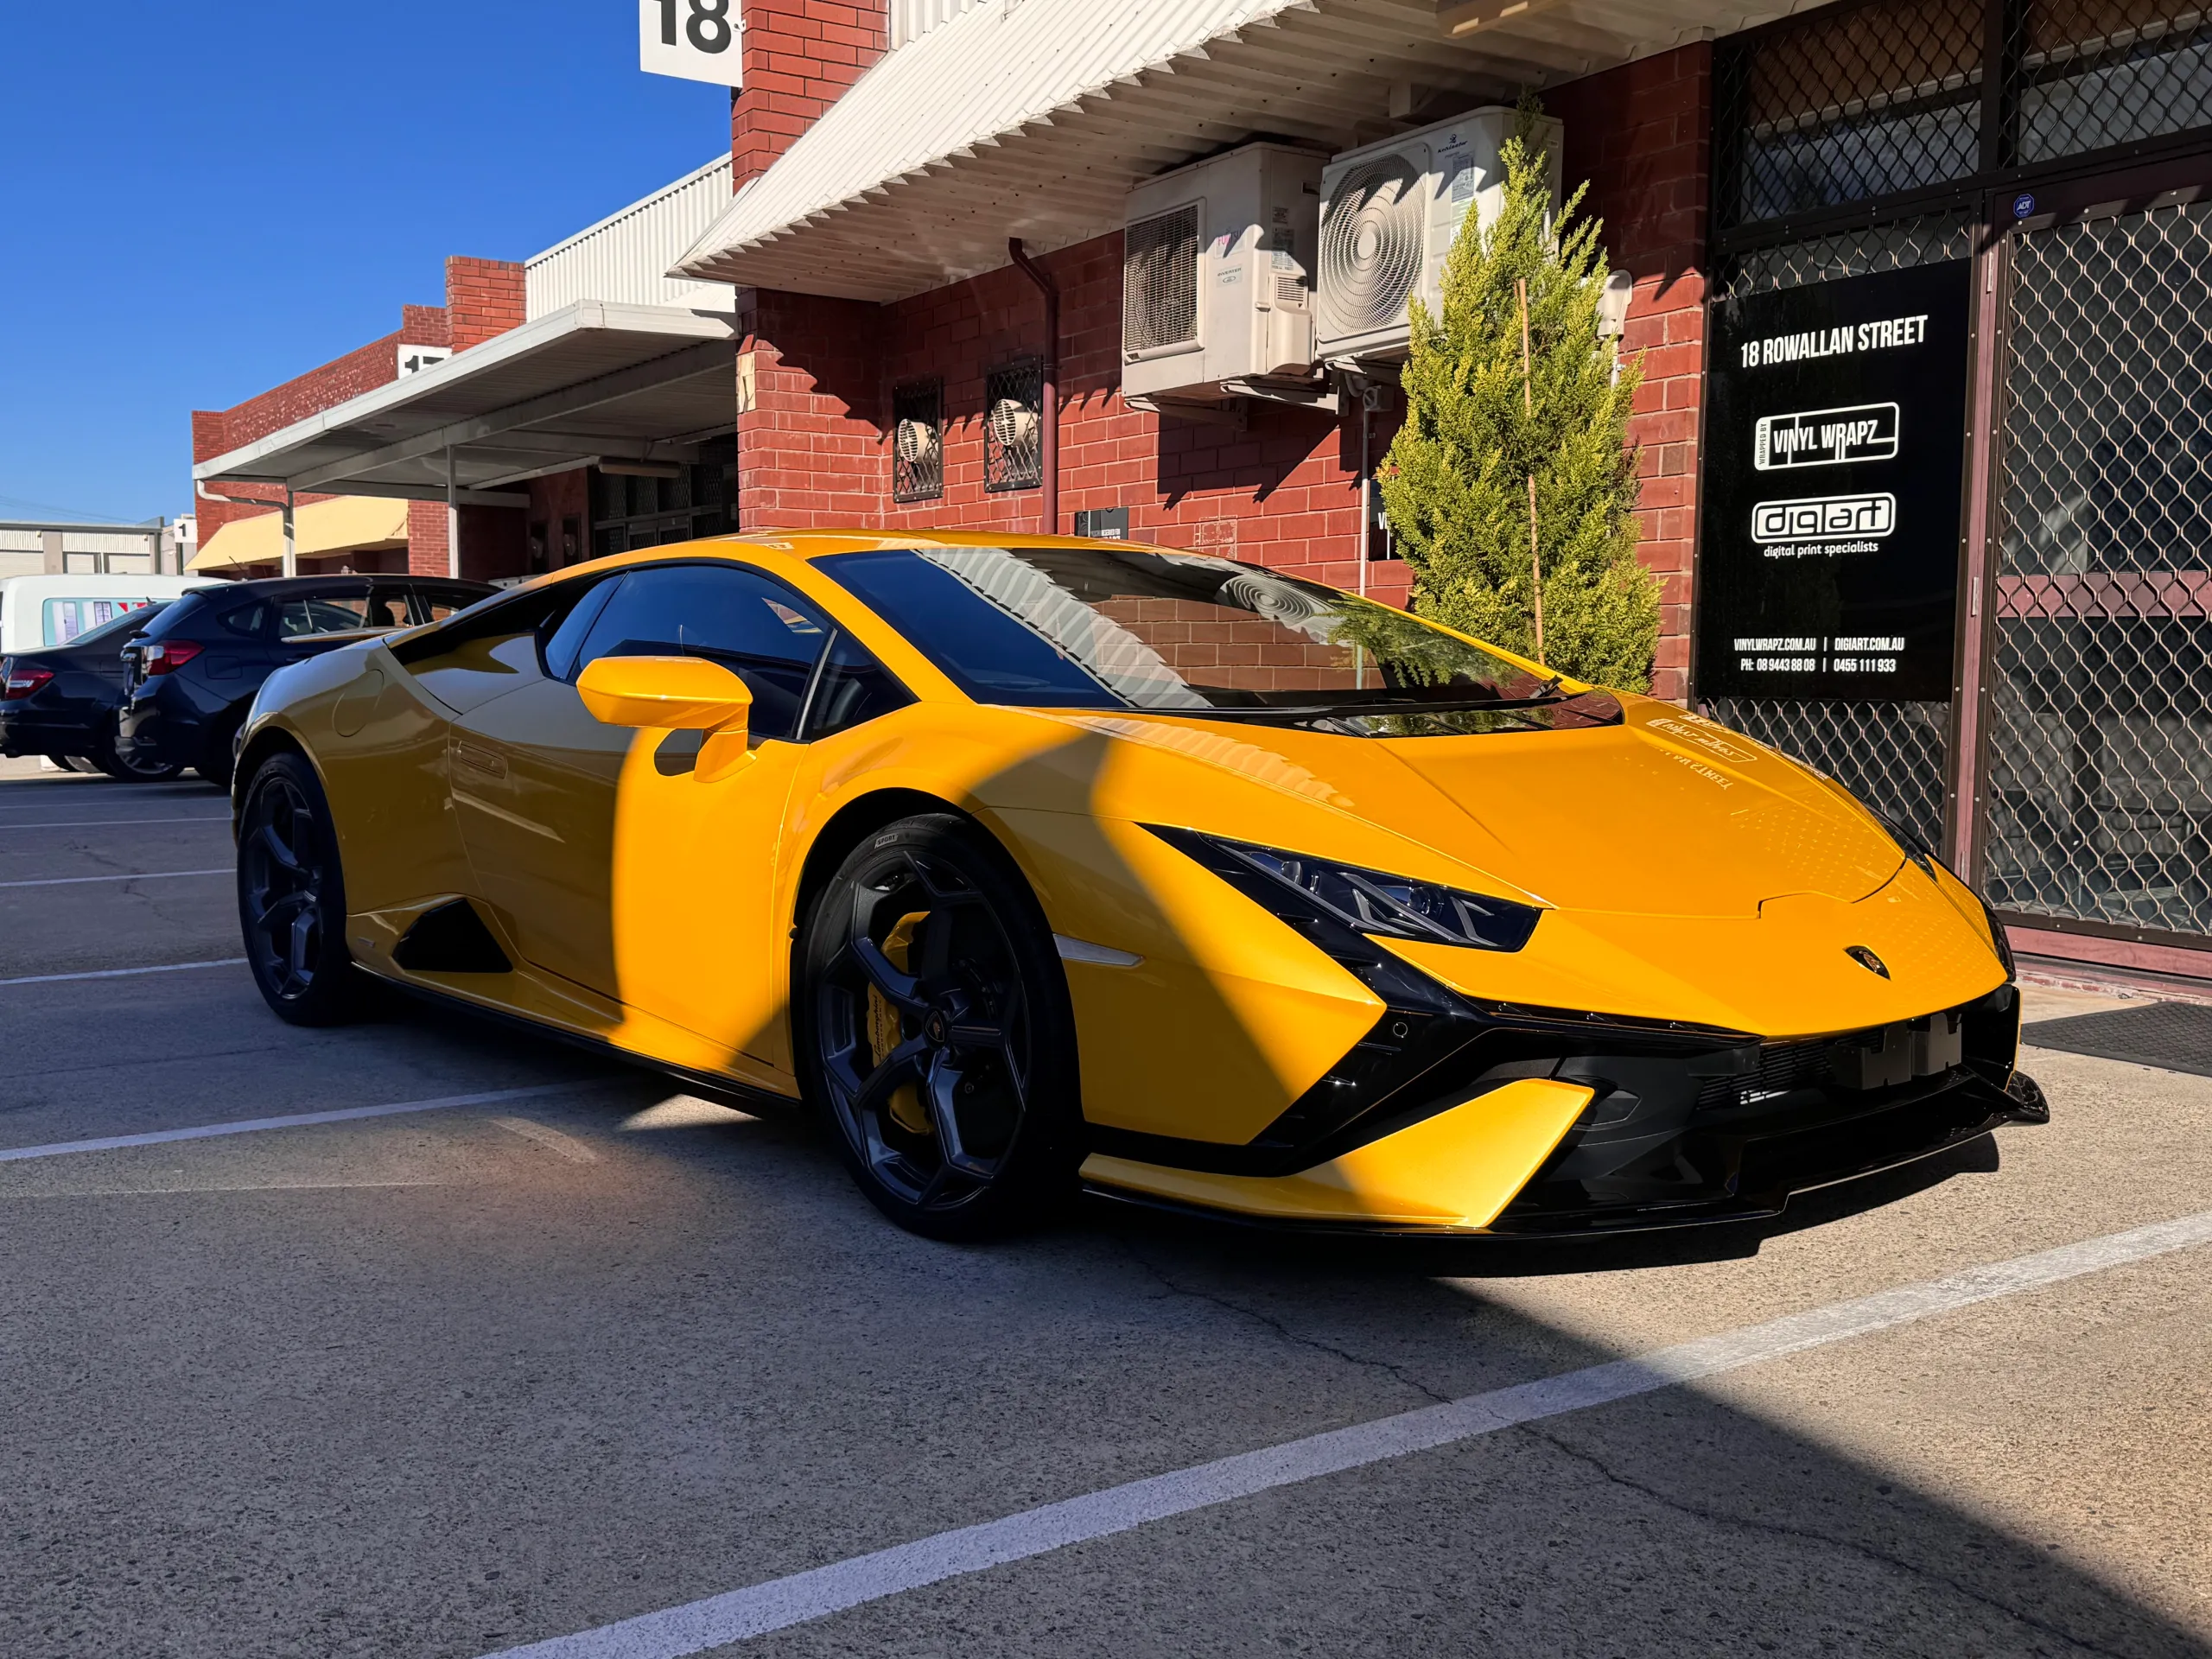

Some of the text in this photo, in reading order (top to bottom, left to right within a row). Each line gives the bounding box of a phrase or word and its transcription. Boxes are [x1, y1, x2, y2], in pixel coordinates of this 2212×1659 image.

[653, 0, 732, 54] 18
[2017, 200, 2031, 211] ADT
[1217, 267, 1242, 277] INVERTER
[1741, 315, 1929, 368] 18 ROWALLAN STREET
[1758, 423, 1767, 465] WRAPPED BY
[1774, 420, 1884, 460] VINYL WRAPZ
[178, 523, 187, 537] 1
[1764, 540, 1878, 560] digital print specialists
[1733, 637, 1905, 652] VINYLWRAPZ.COM.AU DIGIART.COM.AU
[1740, 658, 1755, 671] PH:
[1757, 658, 1768, 671] 08
[1769, 658, 1790, 671] 9443
[1834, 658, 1857, 672] 0455
[1859, 658, 1876, 672] 111
[1878, 658, 1897, 672] 933
[877, 834, 896, 845] SPORT
